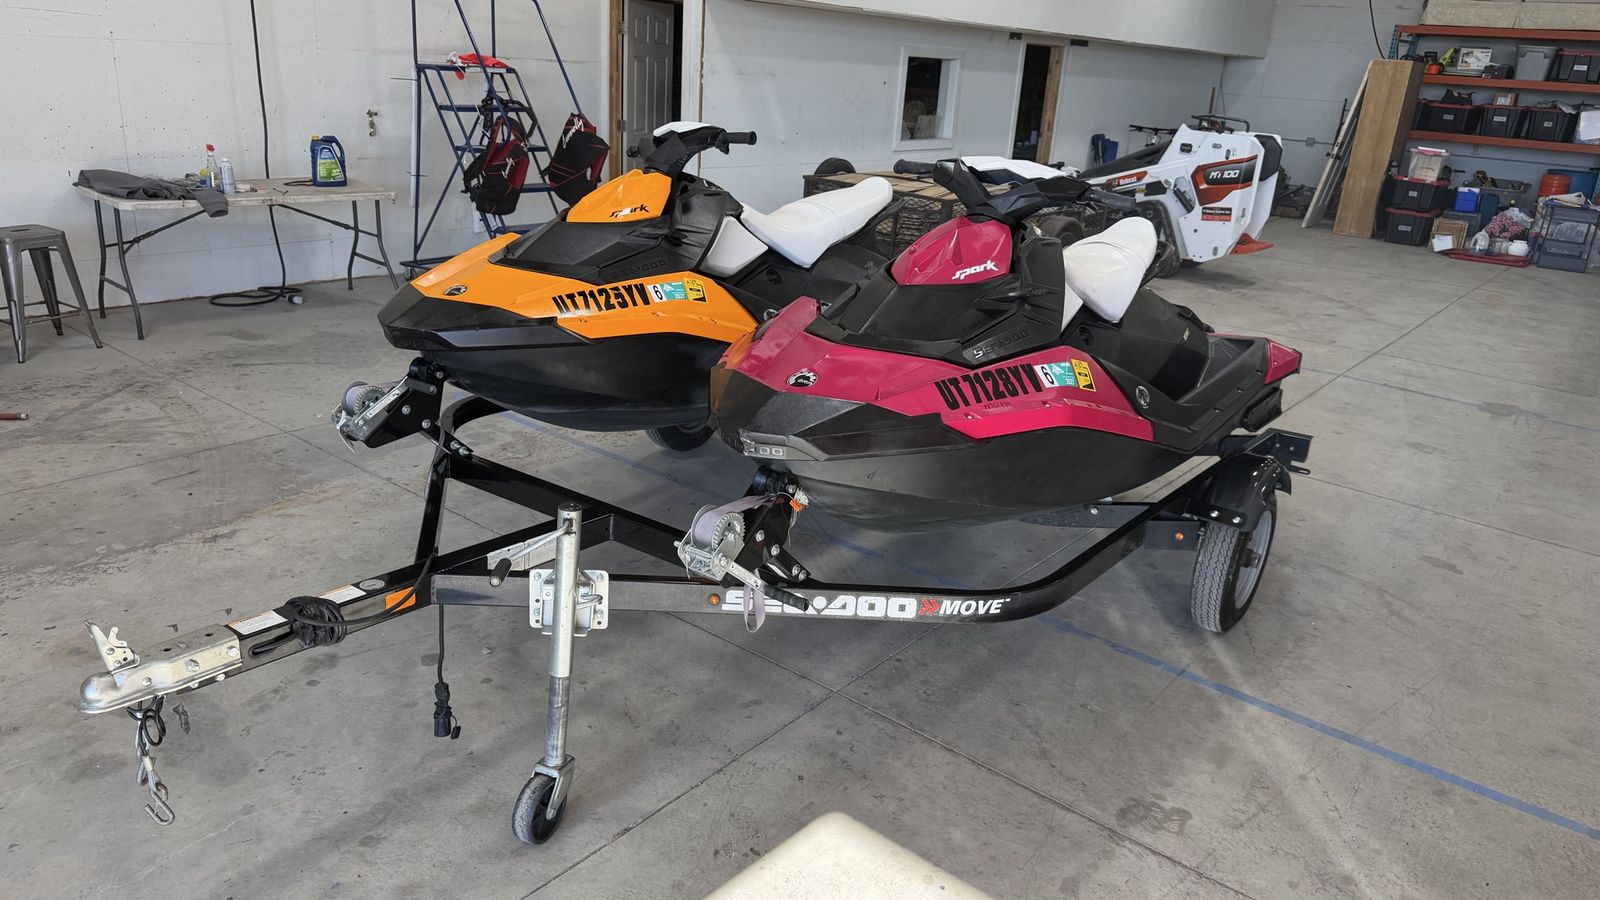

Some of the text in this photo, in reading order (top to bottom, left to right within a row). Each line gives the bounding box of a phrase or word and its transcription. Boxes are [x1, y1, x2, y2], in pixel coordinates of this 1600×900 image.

[951, 259, 1000, 280] spark
[551, 282, 651, 316] UT7125YV
[652, 284, 664, 301] 6
[934, 362, 1044, 411] UT7128YV
[1040, 365, 1055, 386] 6
[939, 598, 1005, 616] MOVE
